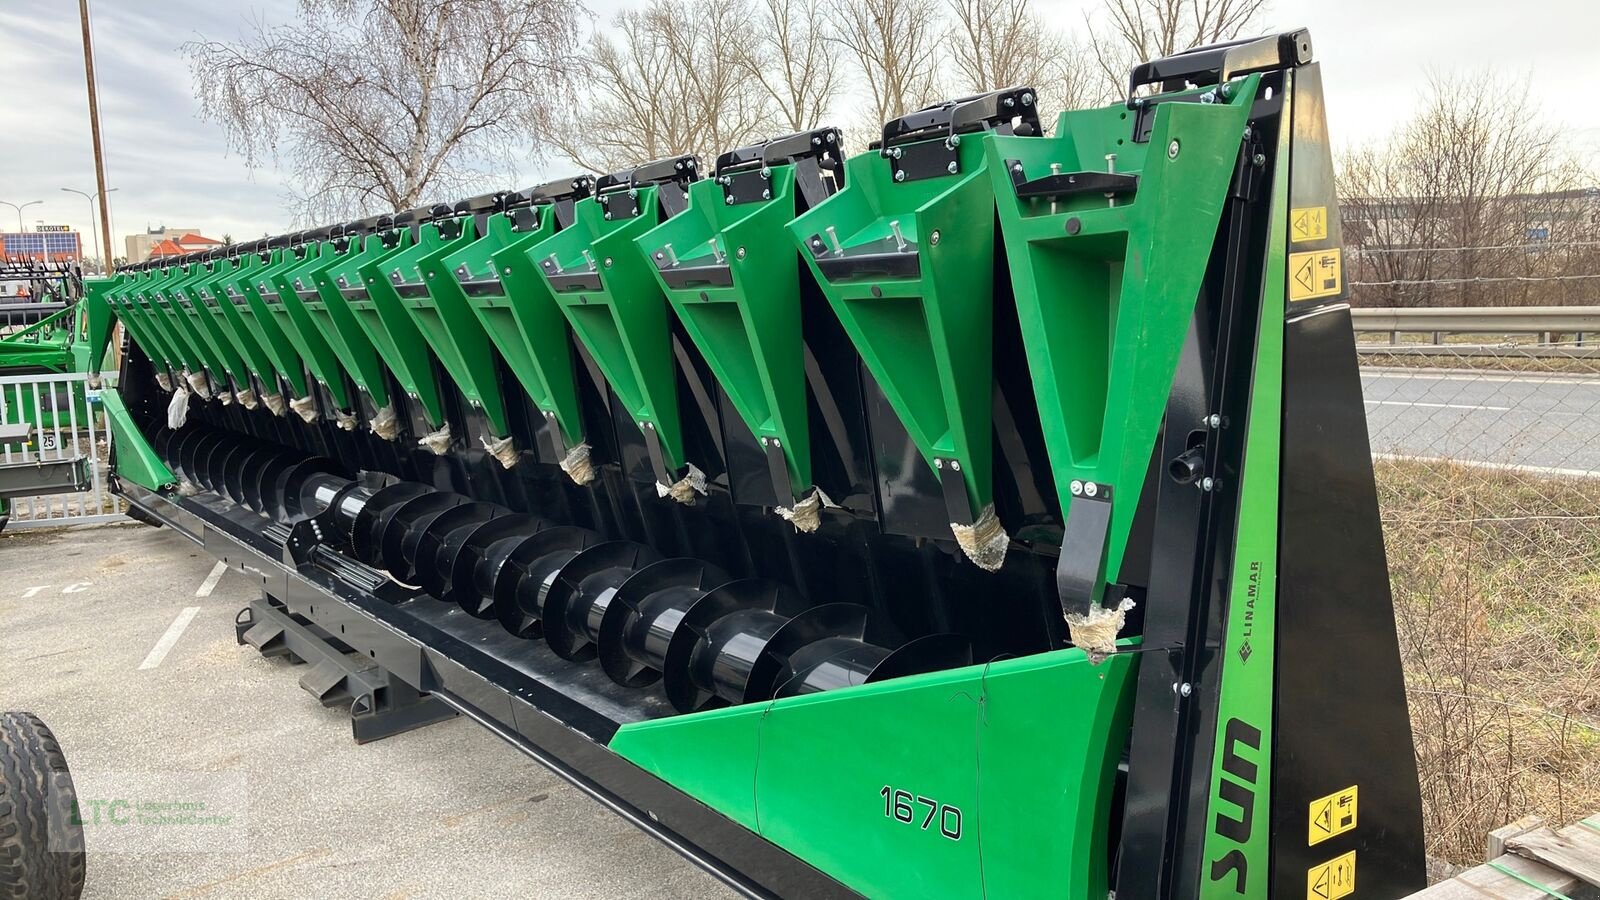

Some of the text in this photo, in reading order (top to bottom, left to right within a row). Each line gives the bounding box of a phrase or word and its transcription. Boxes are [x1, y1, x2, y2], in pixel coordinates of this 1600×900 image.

[43, 436, 54, 447] 25
[1243, 561, 1259, 637] LINAMAR
[880, 785, 963, 841] 1670
